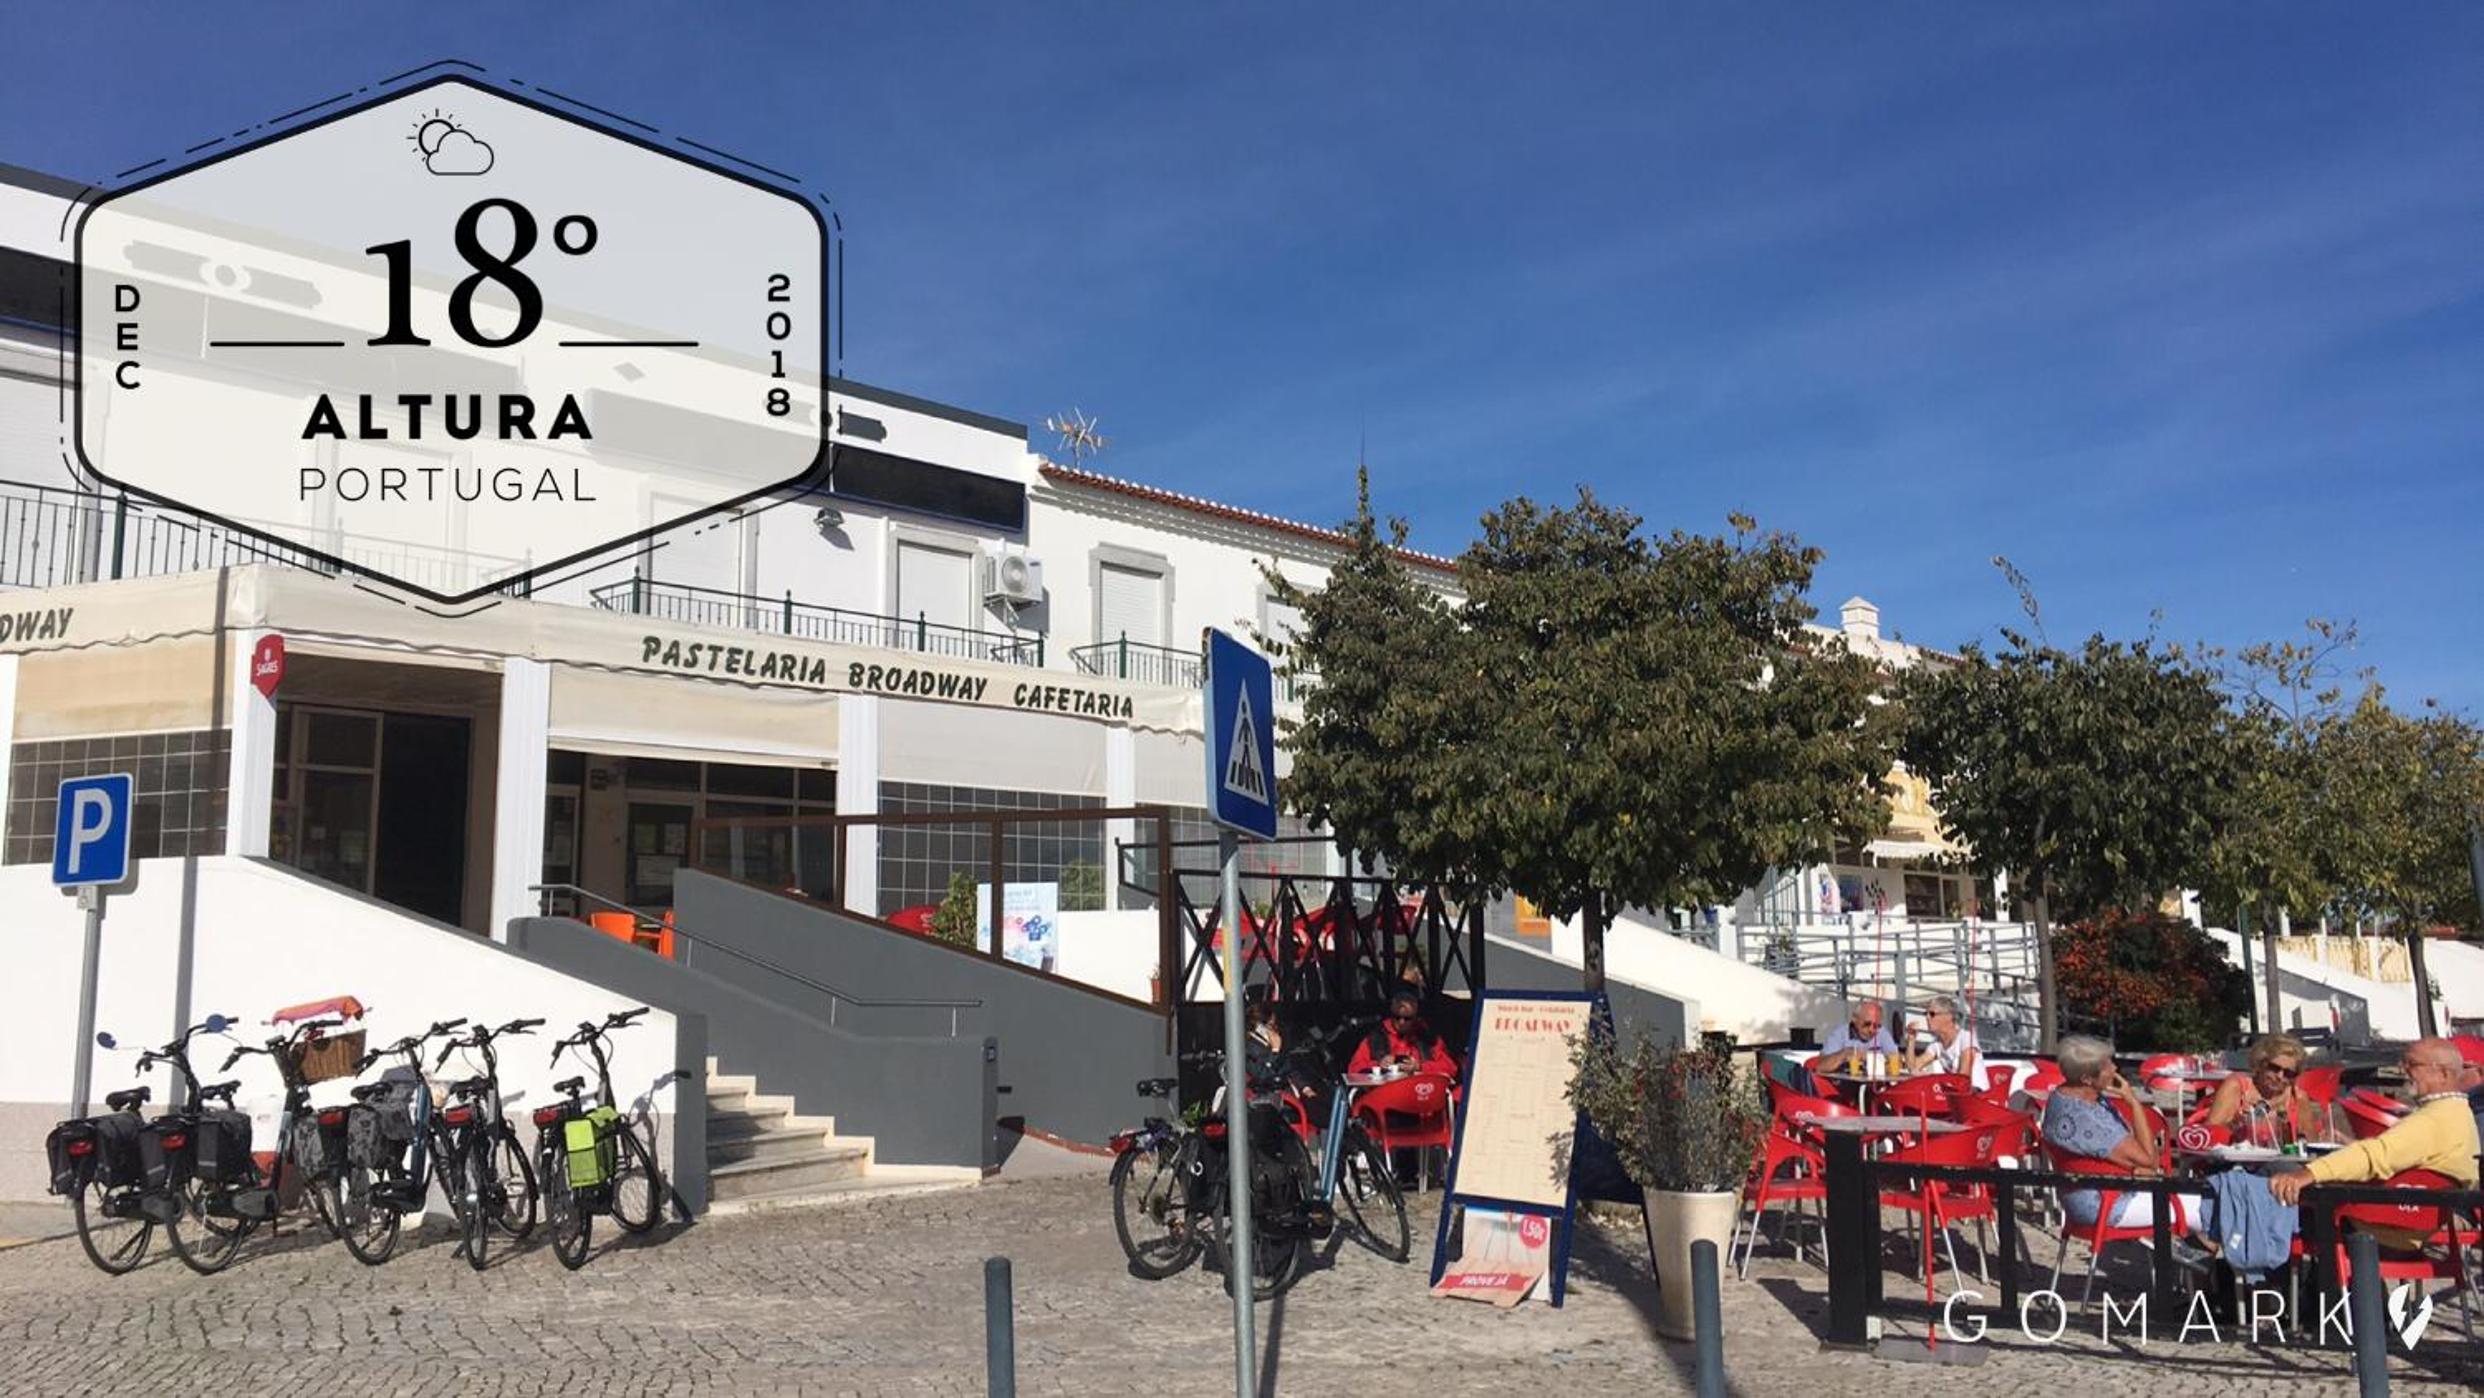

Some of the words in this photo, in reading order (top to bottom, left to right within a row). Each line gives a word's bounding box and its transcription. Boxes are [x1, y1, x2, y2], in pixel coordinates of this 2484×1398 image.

[642, 635, 826, 684] PASTELARIA
[849, 661, 988, 705] BROADWAY
[1013, 683, 1134, 718] CAFETARIA
[67, 788, 113, 874] P
